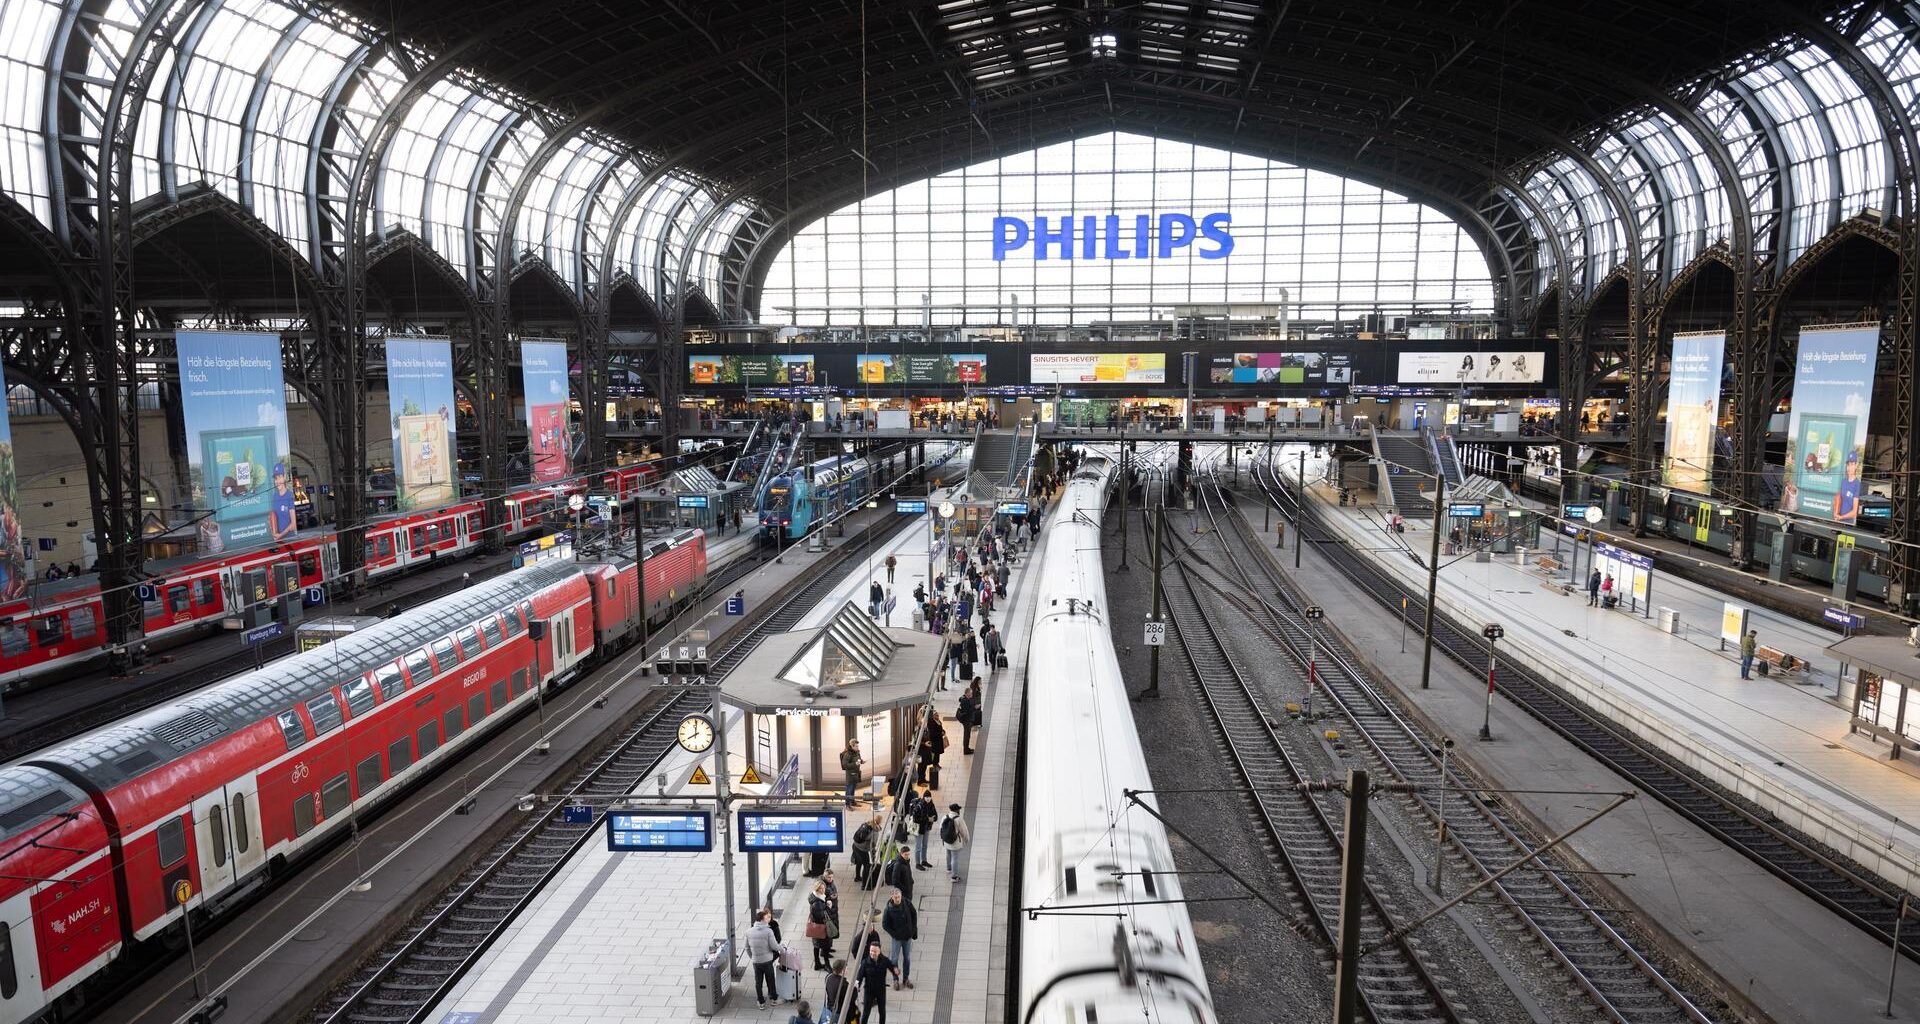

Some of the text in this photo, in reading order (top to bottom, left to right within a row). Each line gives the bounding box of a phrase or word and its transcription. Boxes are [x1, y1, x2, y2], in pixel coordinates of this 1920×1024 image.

[992, 212, 1235, 261] PHILIPS
[1822, 352, 1840, 363] längste
[1840, 350, 1866, 363] Beziehung
[187, 356, 272, 370] Hält die längste Beziehung
[188, 370, 208, 382] frisch.
[140, 586, 149, 598] D
[311, 589, 320, 602] D
[728, 600, 737, 613] E
[1825, 610, 1842, 622] Hamburg
[1146, 624, 1164, 633] 286
[249, 630, 269, 640] Hamburg
[1151, 634, 1158, 642] 6
[464, 672, 480, 688] REGIO
[776, 708, 828, 716] ServiceStore
[314, 792, 320, 804] 2
[618, 817, 625, 826] 7
[830, 818, 836, 827] 8
[68, 898, 100, 924] NAH.SH
